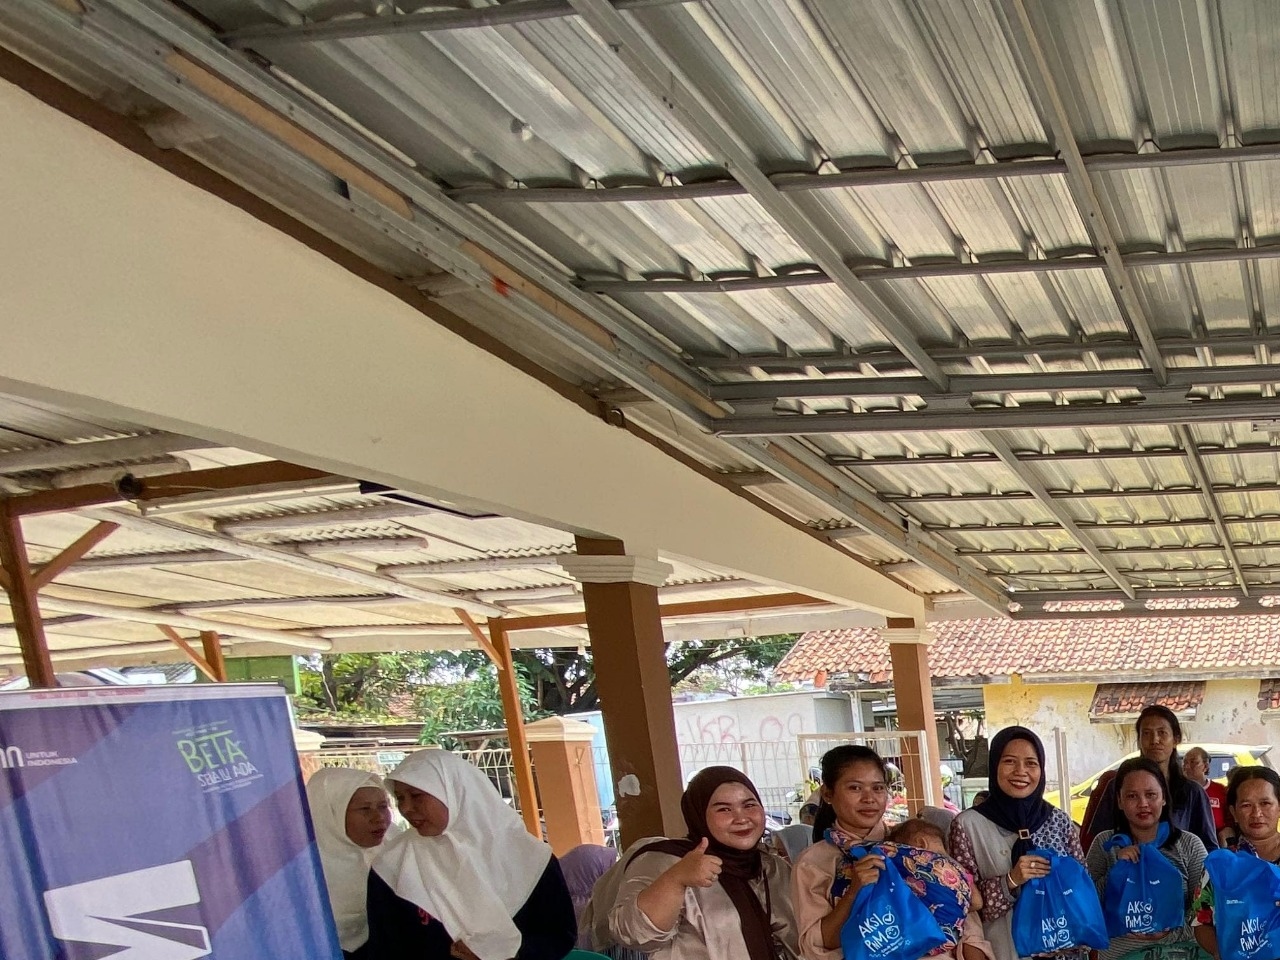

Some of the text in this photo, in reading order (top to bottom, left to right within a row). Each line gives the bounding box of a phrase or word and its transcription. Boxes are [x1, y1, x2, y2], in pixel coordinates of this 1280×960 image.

[177, 729, 248, 773] BETA
[232, 761, 259, 778] ADA
[1127, 900, 1144, 914] AKS
[859, 913, 884, 938] AKSI
[1041, 917, 1058, 934] AKS
[1241, 916, 1260, 936] AKSI
